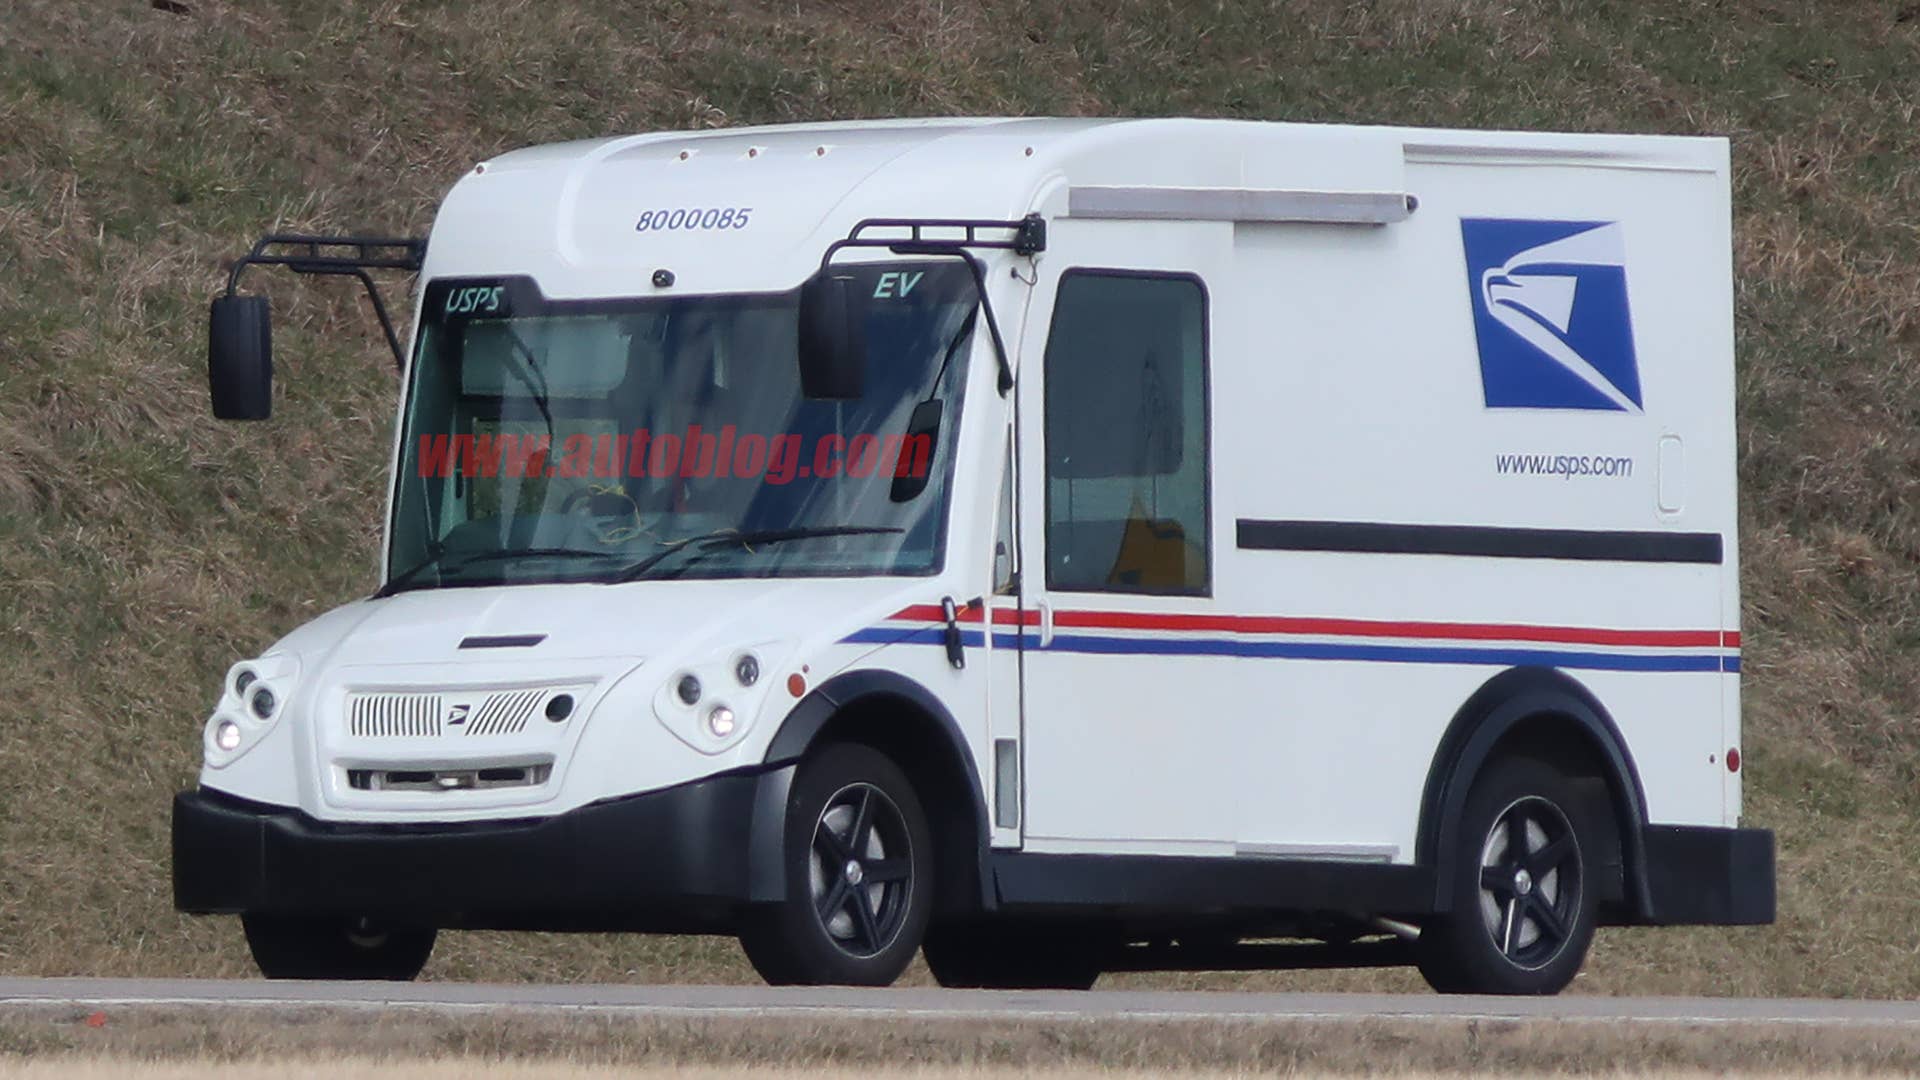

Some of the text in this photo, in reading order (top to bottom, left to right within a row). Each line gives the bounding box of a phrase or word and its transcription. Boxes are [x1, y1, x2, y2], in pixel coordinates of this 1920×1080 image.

[635, 207, 752, 232] 8000085
[873, 271, 923, 298] EV
[445, 286, 504, 314] USPS
[1496, 453, 1633, 480] www.usps.com
